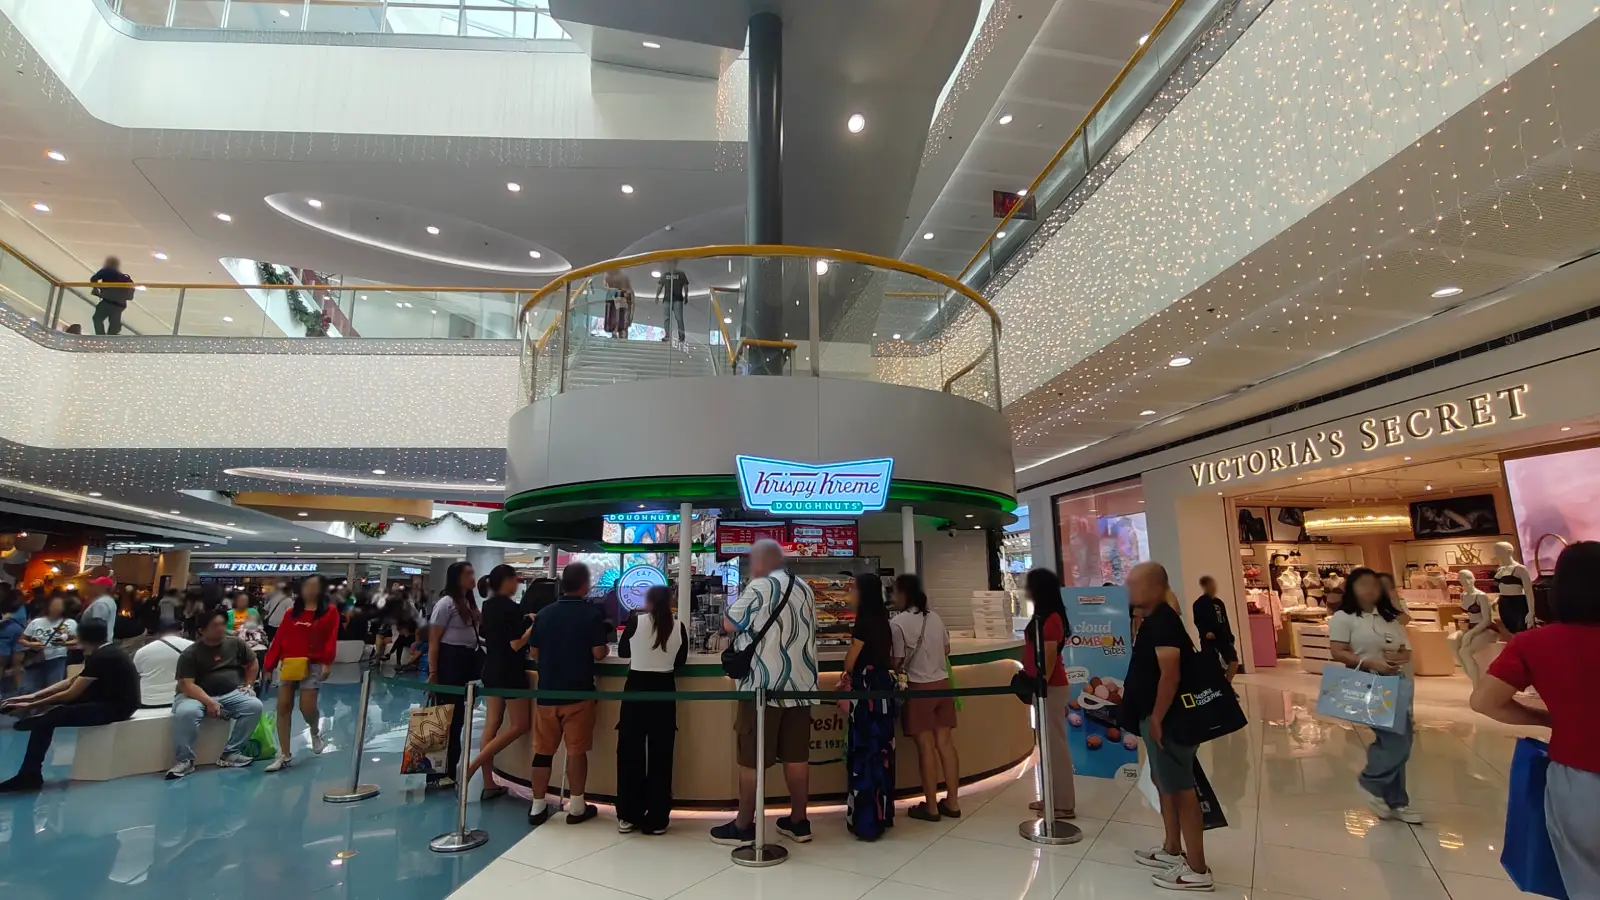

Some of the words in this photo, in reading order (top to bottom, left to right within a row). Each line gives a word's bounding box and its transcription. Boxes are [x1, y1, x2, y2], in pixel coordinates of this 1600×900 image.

[1189, 429, 1346, 487] VICTORIA'S
[1359, 384, 1529, 451] SECRET
[754, 471, 819, 498] Krispy
[819, 472, 882, 495] Kreme
[775, 502, 858, 510] DOUGHNUTS
[230, 563, 278, 571] FRENCH
[278, 563, 318, 571] BAKER
[1074, 620, 1112, 633] cloud
[1103, 646, 1126, 656] bites
